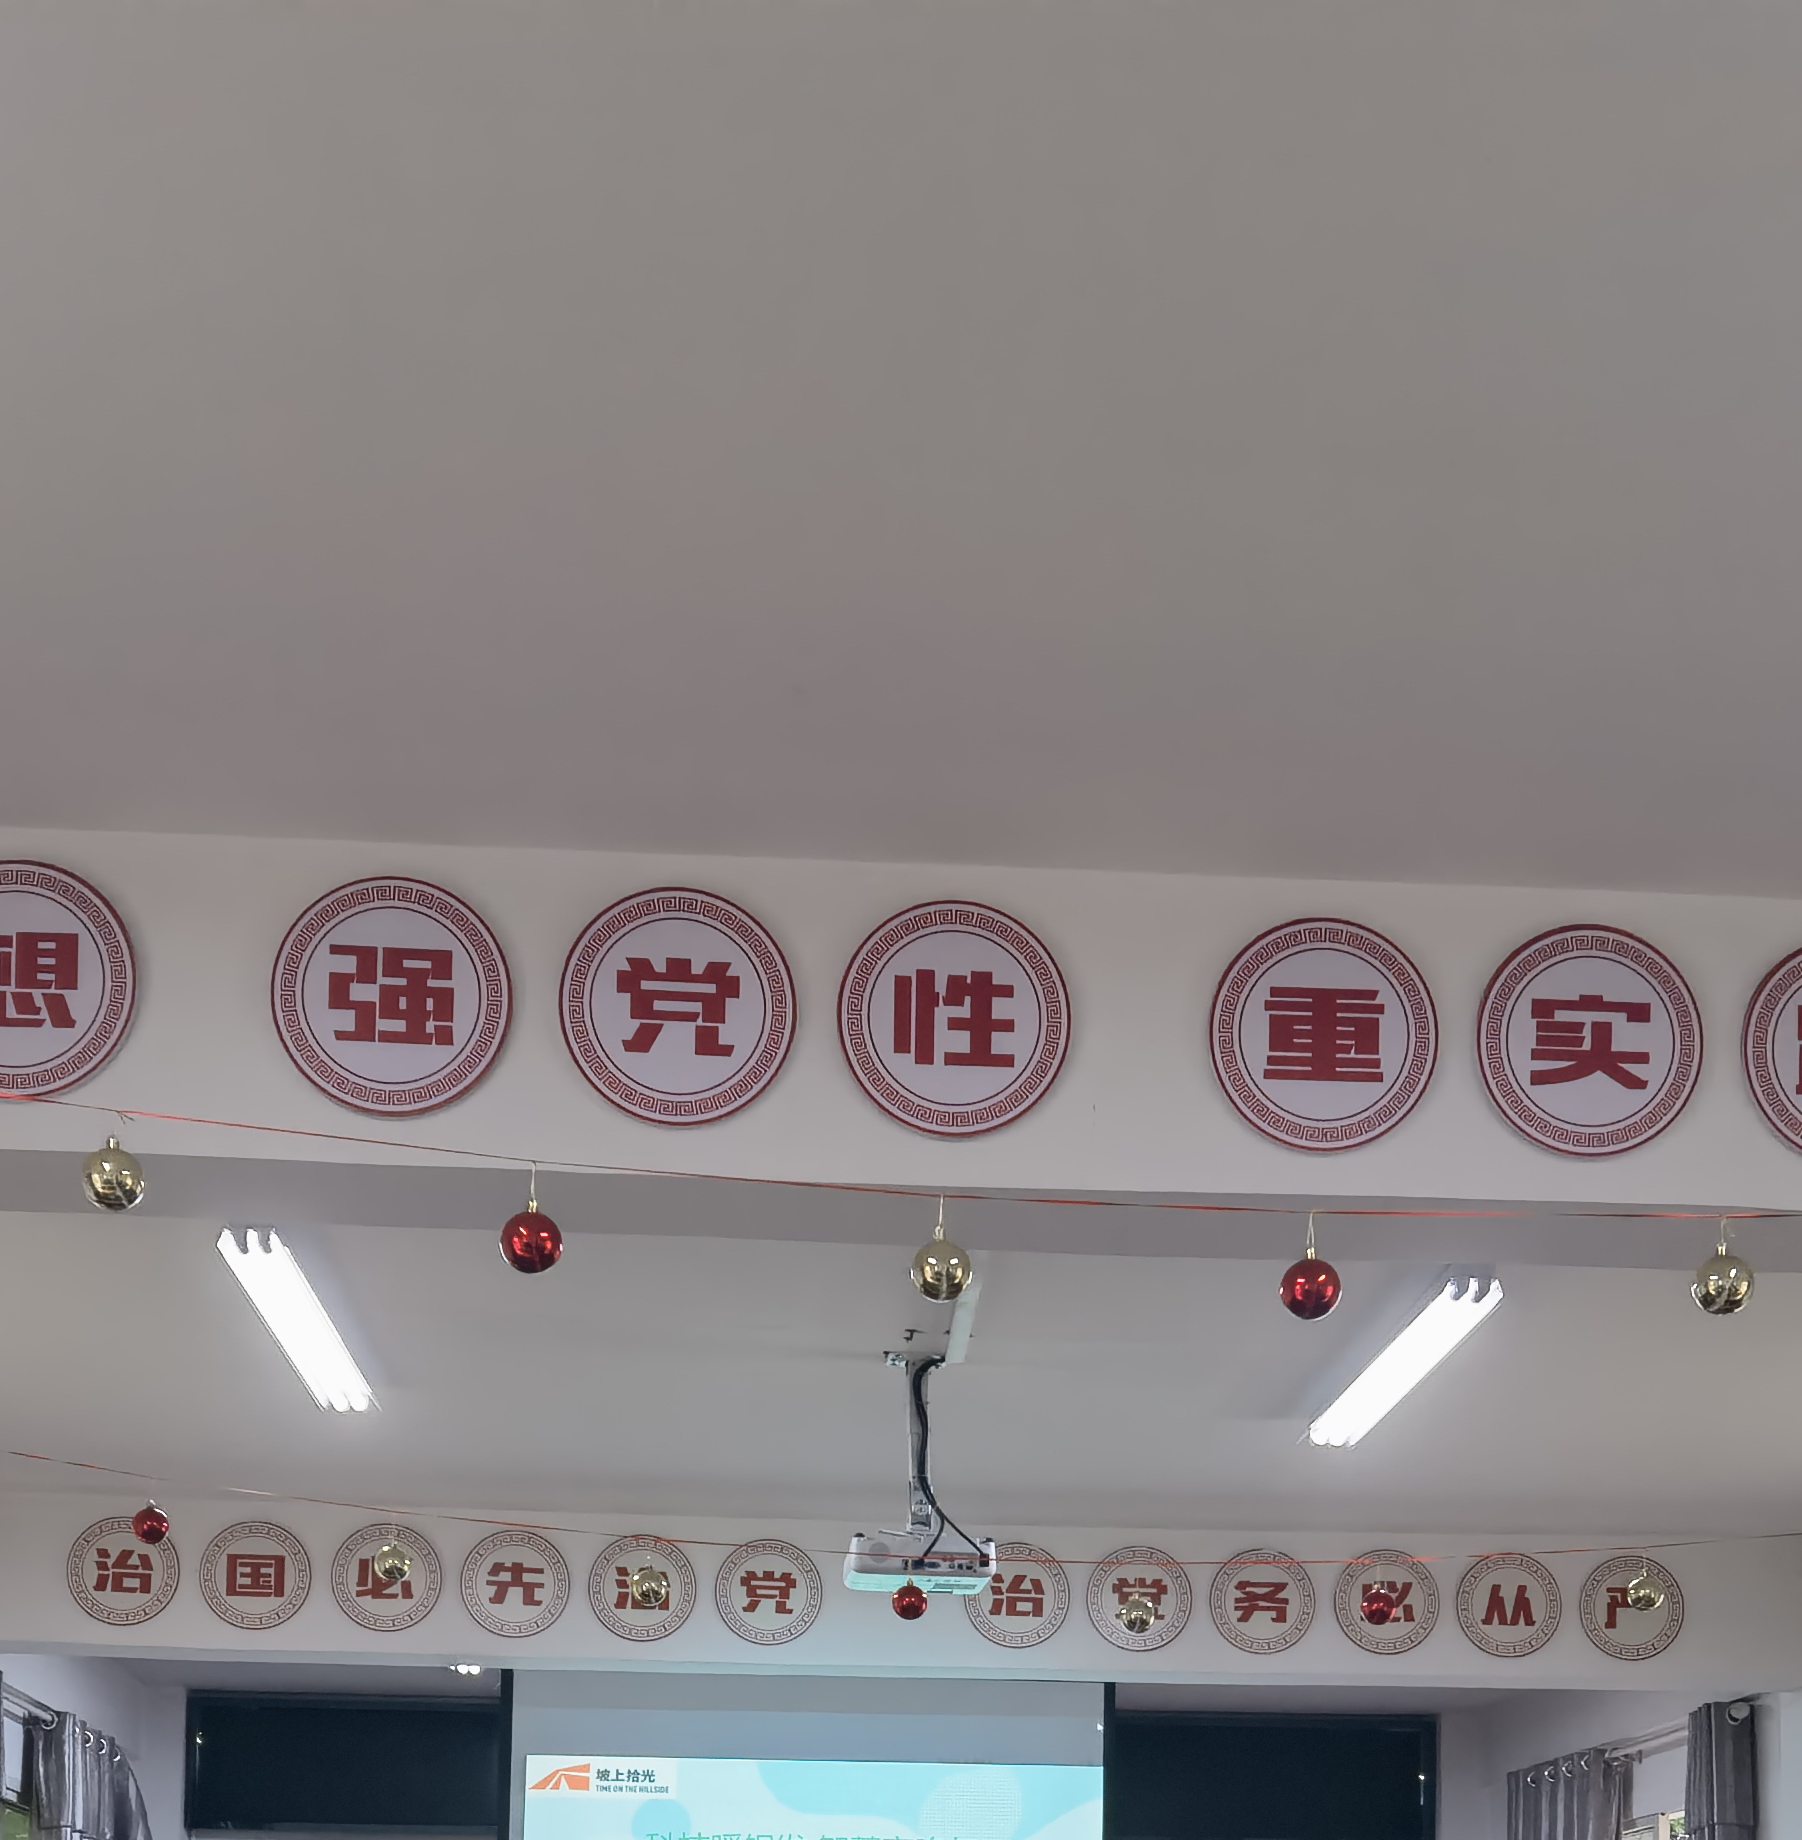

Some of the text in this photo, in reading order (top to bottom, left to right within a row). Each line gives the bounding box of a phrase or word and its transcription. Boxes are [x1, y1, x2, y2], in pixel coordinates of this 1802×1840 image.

[329, 946, 1015, 1068] 强党性
[596, 1768, 656, 1783] 坡上拾光
[596, 1785, 669, 1794] TIME ON THE HILLSIDE
